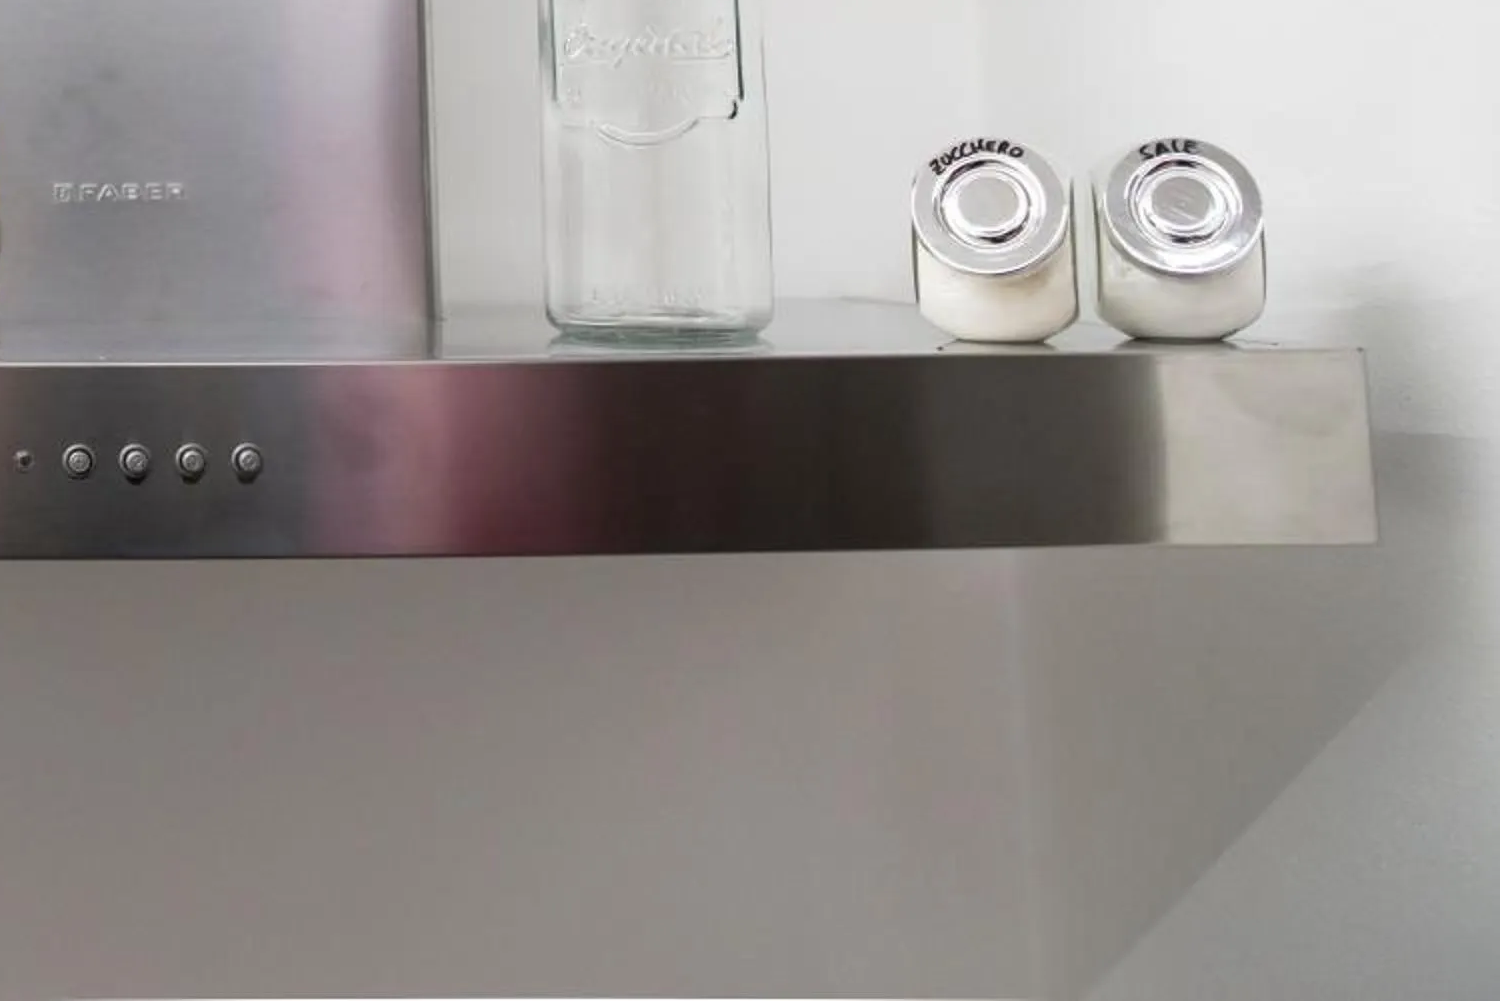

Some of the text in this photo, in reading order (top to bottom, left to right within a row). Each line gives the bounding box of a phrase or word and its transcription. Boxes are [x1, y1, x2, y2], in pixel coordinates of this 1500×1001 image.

[929, 138, 1024, 176] ZUCCHERO
[1138, 138, 1199, 161] SALE
[78, 181, 186, 201] FABER
